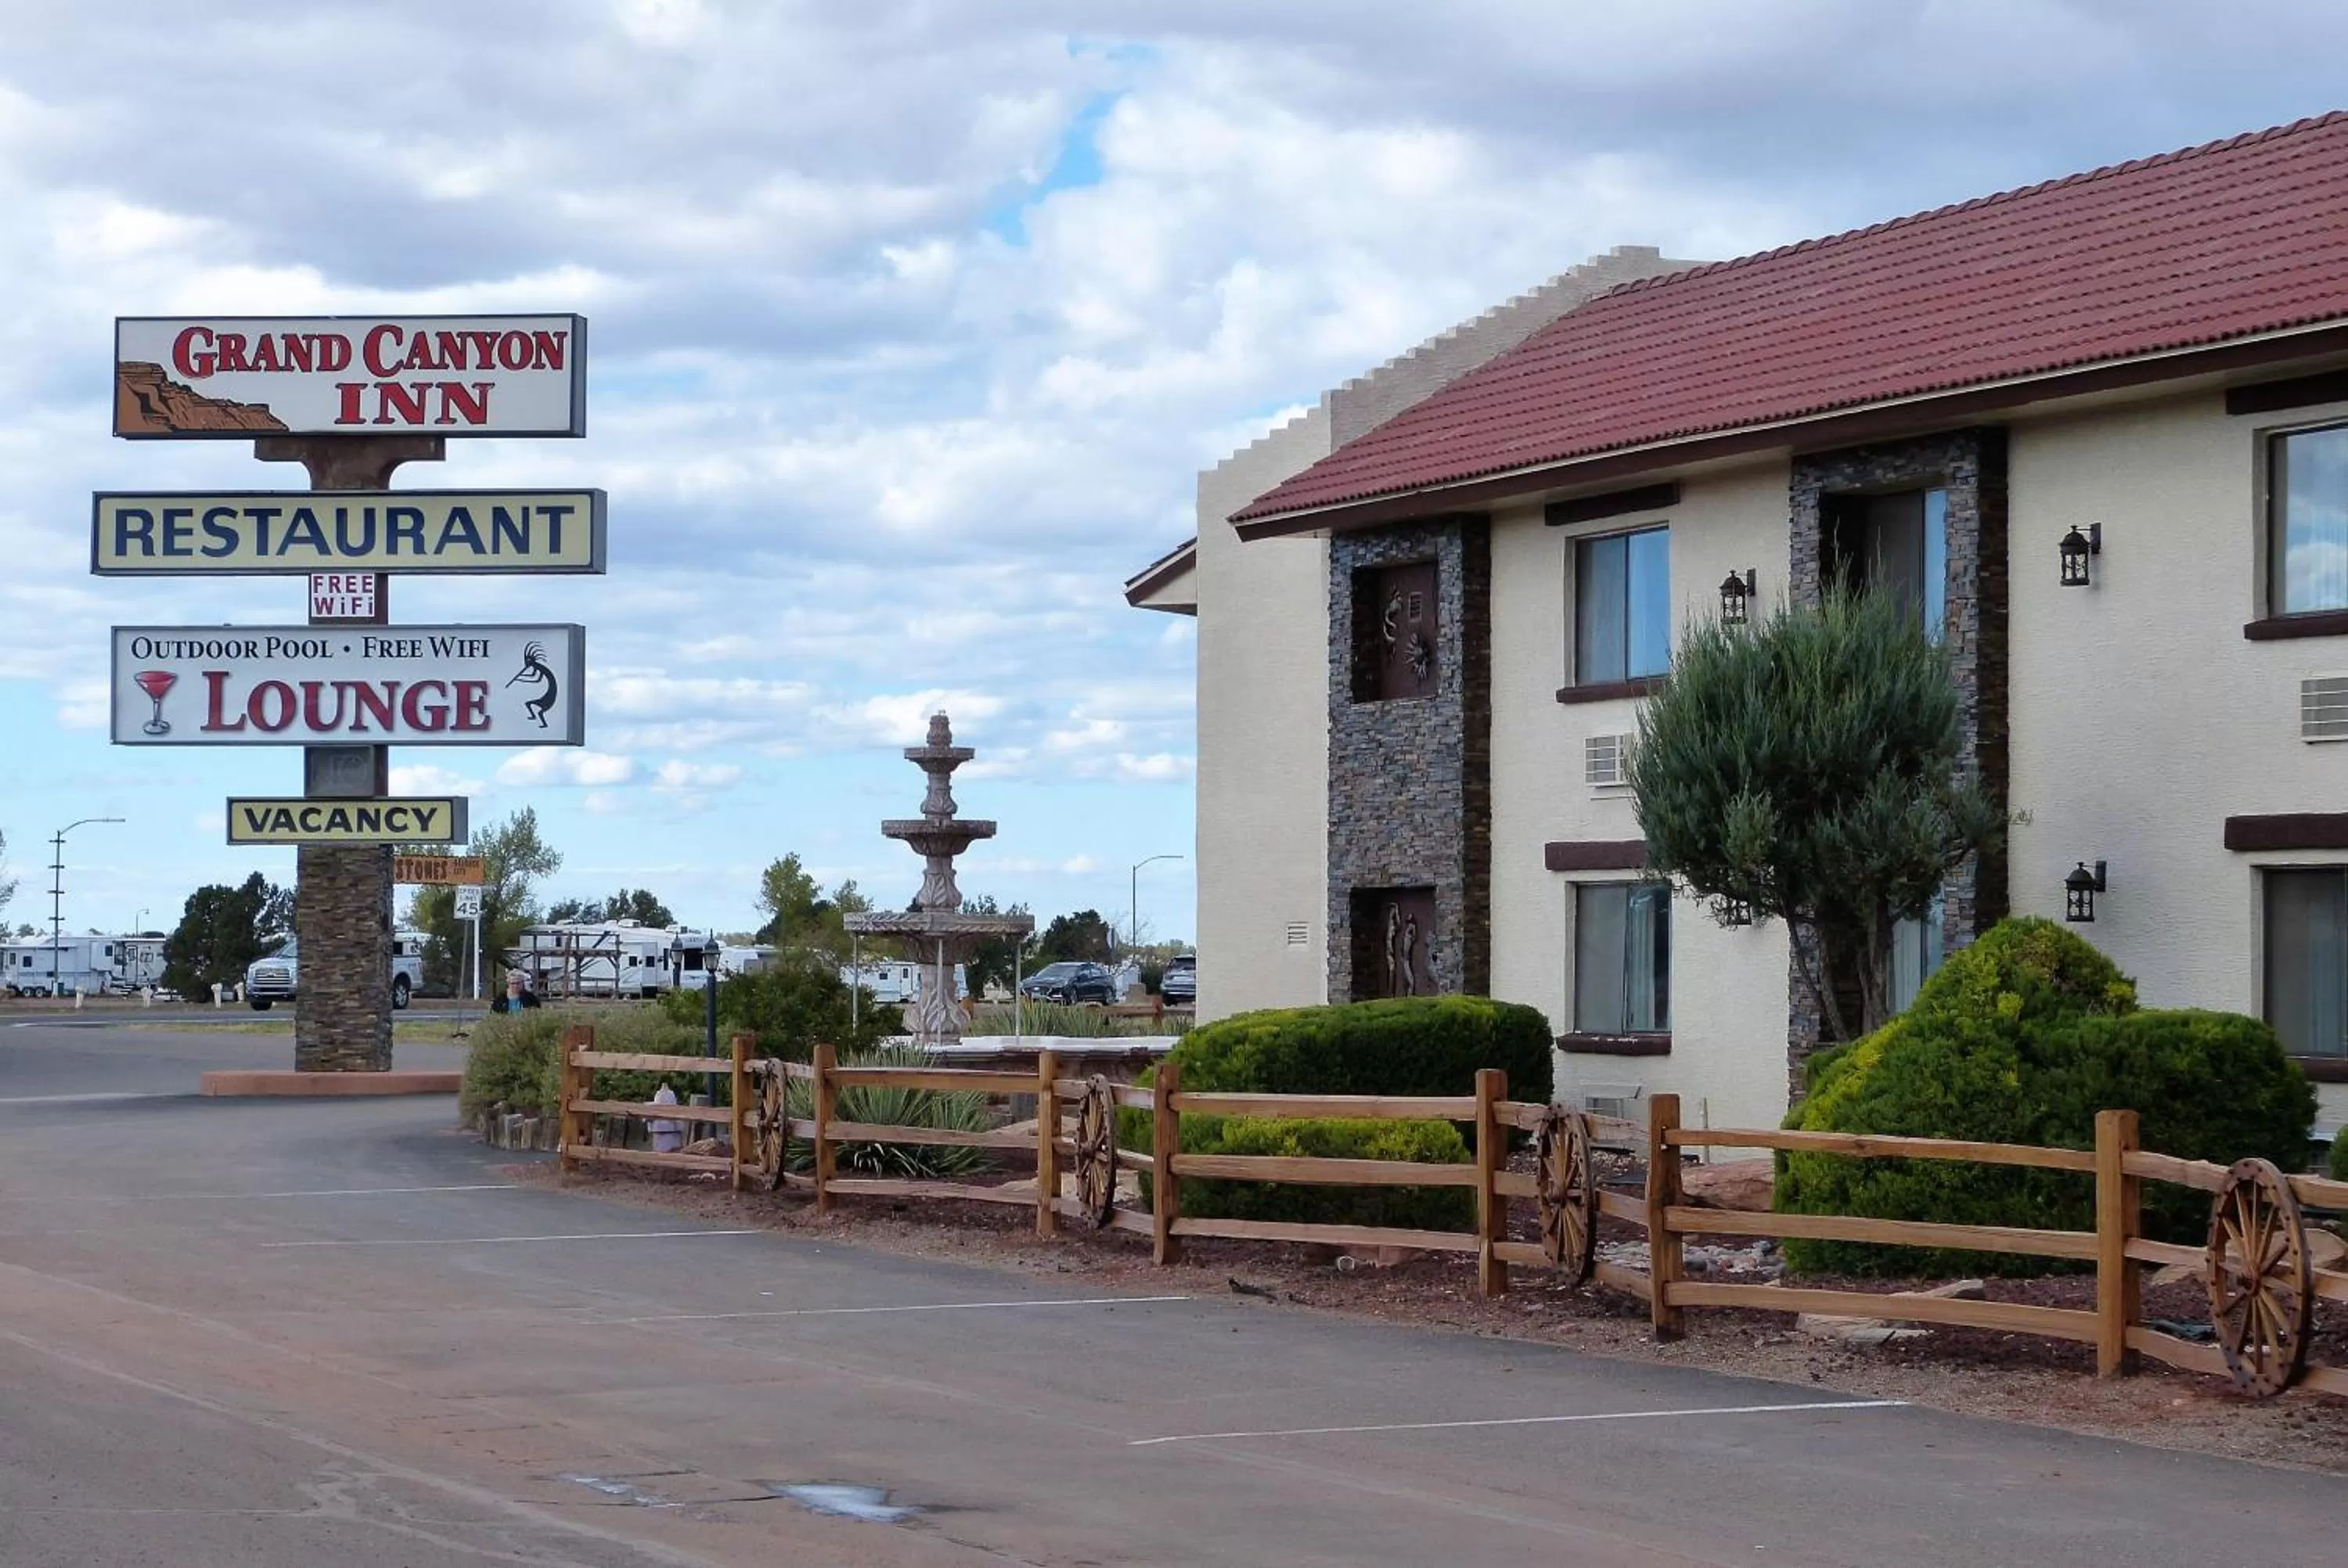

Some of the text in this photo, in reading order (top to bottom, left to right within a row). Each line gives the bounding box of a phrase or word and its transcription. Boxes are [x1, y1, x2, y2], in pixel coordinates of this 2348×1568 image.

[171, 324, 567, 379] GRAND CANYON
[334, 382, 495, 425] INN
[114, 505, 575, 558] RESTAURANT
[313, 575, 373, 594] FREE
[314, 597, 373, 615] WiFi
[131, 636, 259, 660] OUTDOOR
[264, 636, 334, 660] POOL
[362, 636, 424, 659] FREE
[200, 670, 492, 732] LOUNGE
[243, 807, 438, 834] VACANCY
[456, 902, 479, 915] 45
